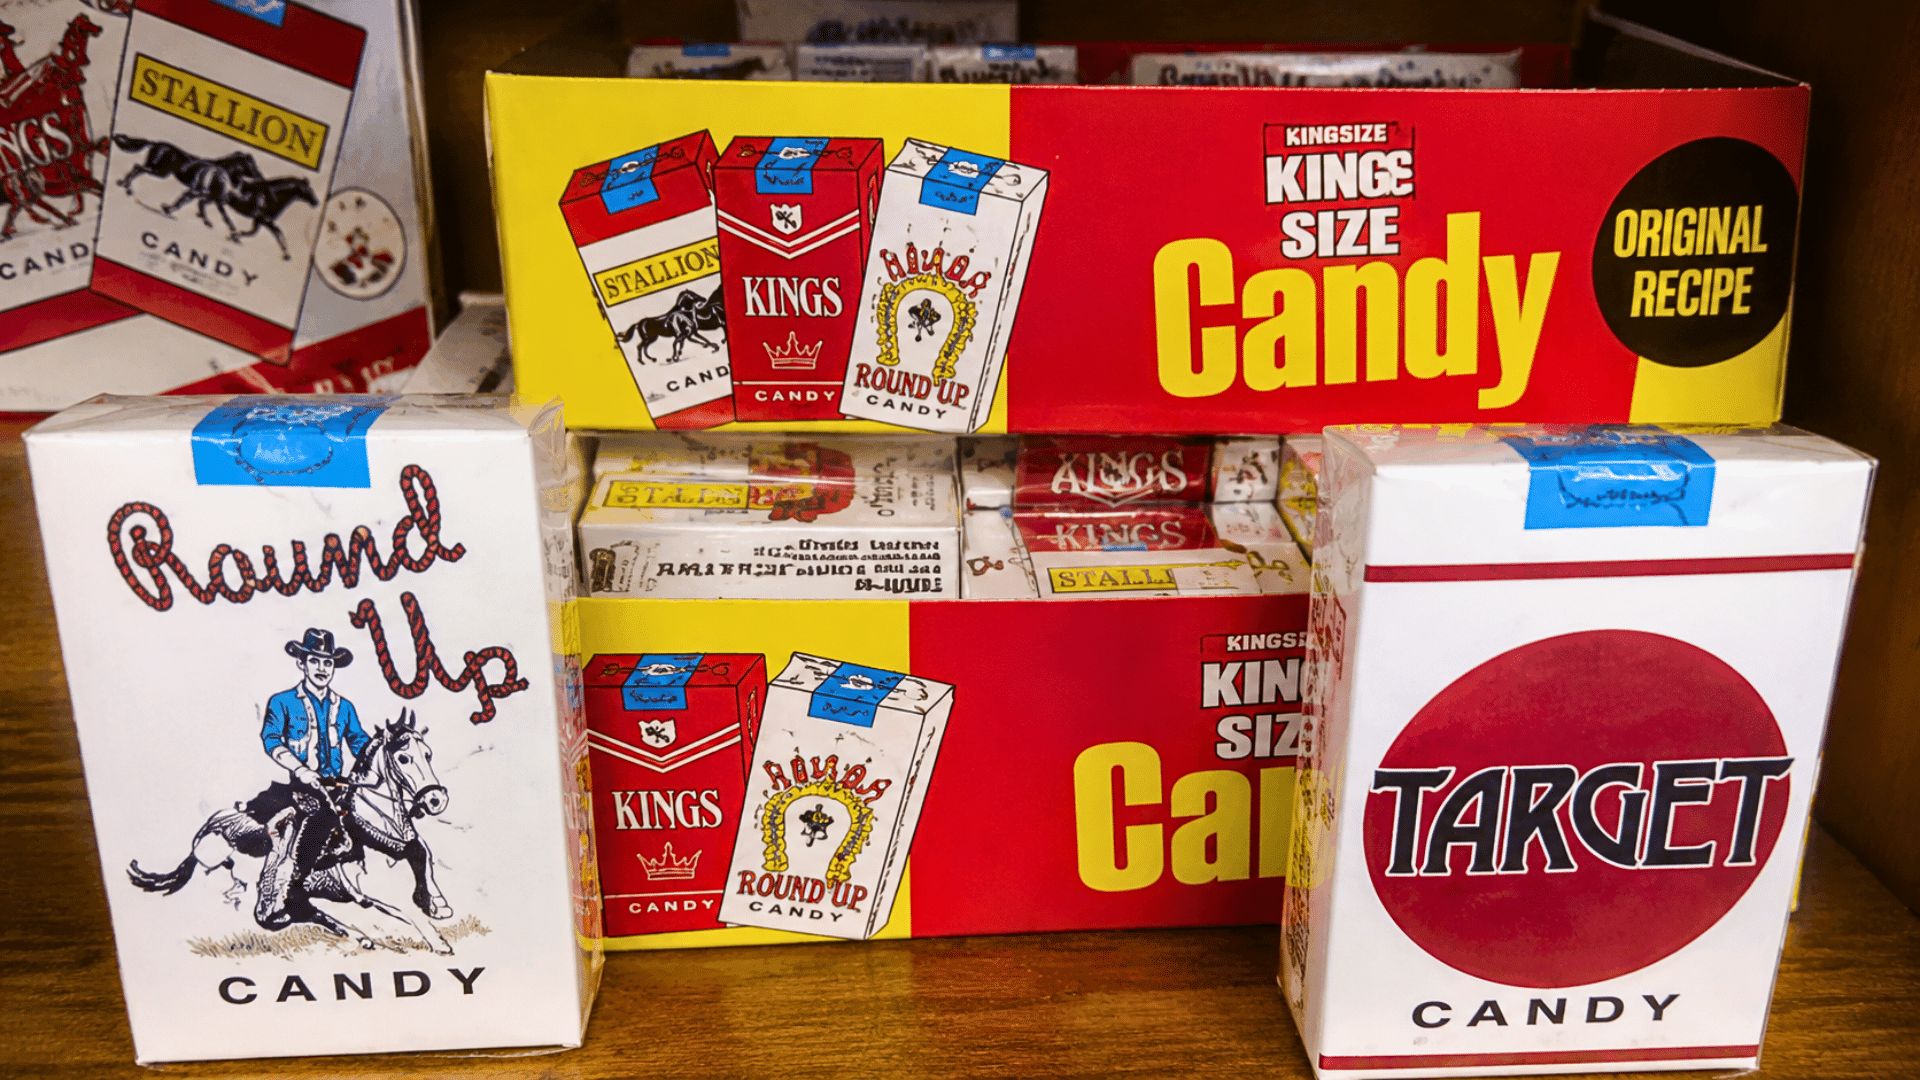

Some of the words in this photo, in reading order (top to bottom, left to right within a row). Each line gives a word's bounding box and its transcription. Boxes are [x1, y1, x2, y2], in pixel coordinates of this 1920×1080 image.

[139, 68, 319, 159] STALLION
[1285, 122, 1388, 147] KINGSIZE
[1280, 206, 1400, 260] SIZE
[1613, 205, 1768, 258] ORIGINAL
[0, 241, 91, 281] CAND
[141, 231, 259, 288] CANDY
[741, 275, 844, 317] KINGS
[1153, 211, 1561, 410] Candy
[1630, 267, 1754, 318] RECIPE
[666, 365, 730, 392] CAND
[754, 390, 836, 402] CANDY
[853, 362, 932, 400] ROUND
[937, 379, 969, 409] UP
[866, 394, 947, 419] CANDY
[107, 464, 466, 612] Round
[347, 591, 529, 725] Up
[1202, 658, 1305, 709] KIN
[1216, 712, 1303, 760] SIZ
[611, 788, 724, 831] KINGS
[1370, 757, 1796, 877] TARGET
[629, 899, 715, 914] CANDY
[736, 870, 826, 904] ROUND
[831, 878, 868, 912] UP
[749, 901, 843, 922] CANDY
[217, 967, 486, 1005] CANDY
[1411, 994, 1681, 1028] CANDY
